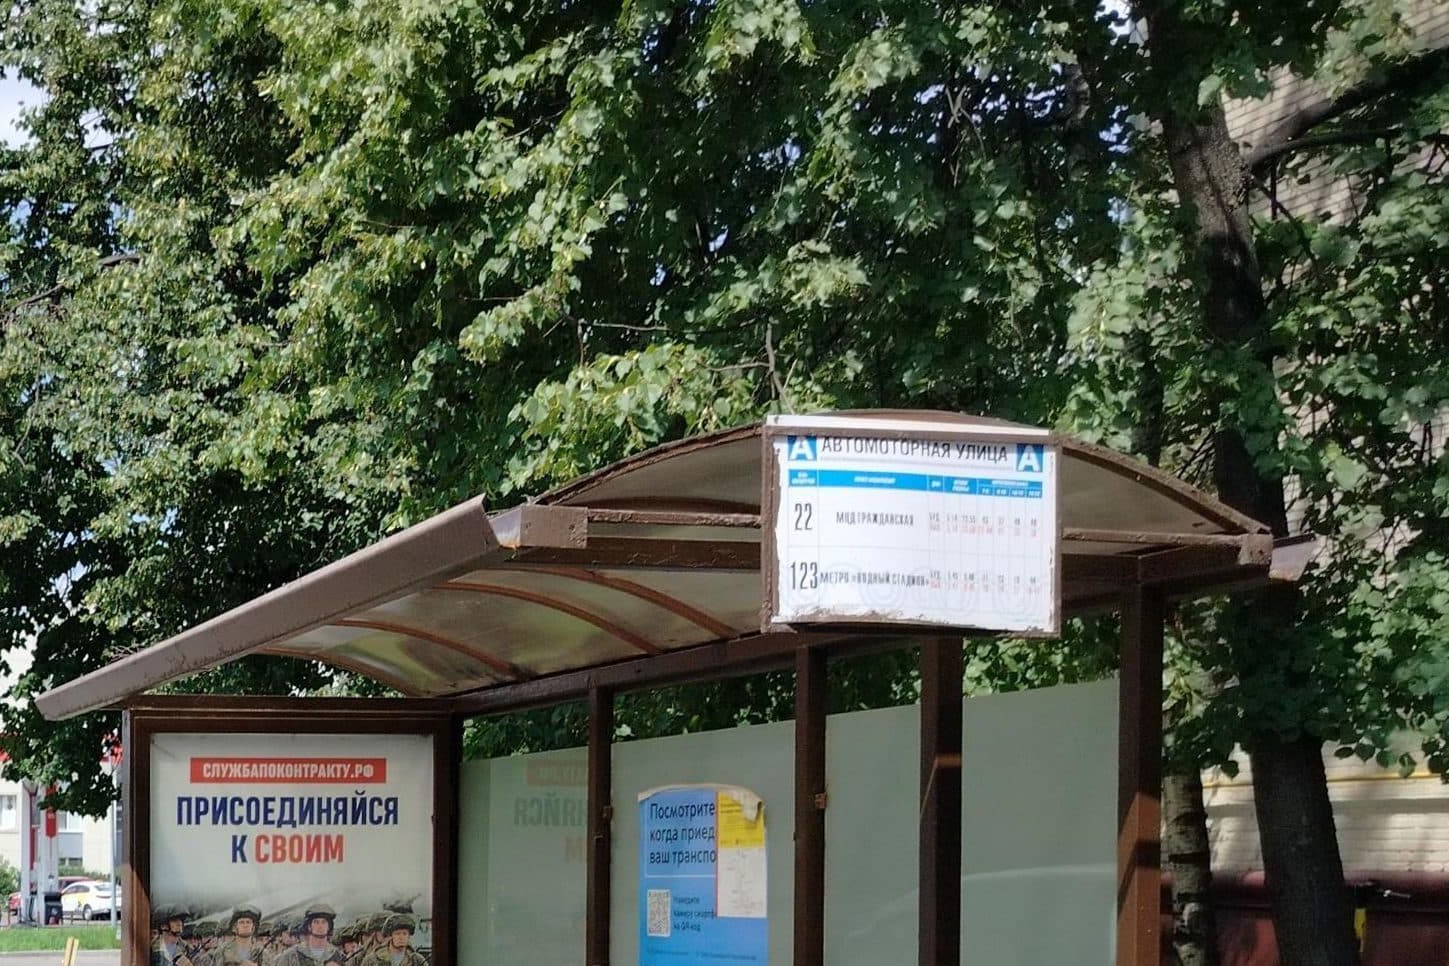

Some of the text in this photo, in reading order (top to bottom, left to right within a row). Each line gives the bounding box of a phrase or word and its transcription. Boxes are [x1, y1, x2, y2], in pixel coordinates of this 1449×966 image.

[822, 436, 951, 458] АВТОМОТОРНАЯ
[956, 443, 1008, 463] УЛИЦА
[794, 503, 813, 530] 22
[790, 562, 818, 590] 123
[820, 572, 849, 584] МЕТРО
[202, 762, 374, 779] СЛУЖБАПОКОНТРАКТУ.РФ
[176, 790, 399, 828] ПРИСОЕДИНЯЙСЯ
[650, 802, 716, 820] Посмотрите
[231, 834, 344, 863] К СВОИМ
[650, 827, 679, 842] когда
[681, 826, 716, 844] приед
[650, 850, 716, 867] ваш транспо
